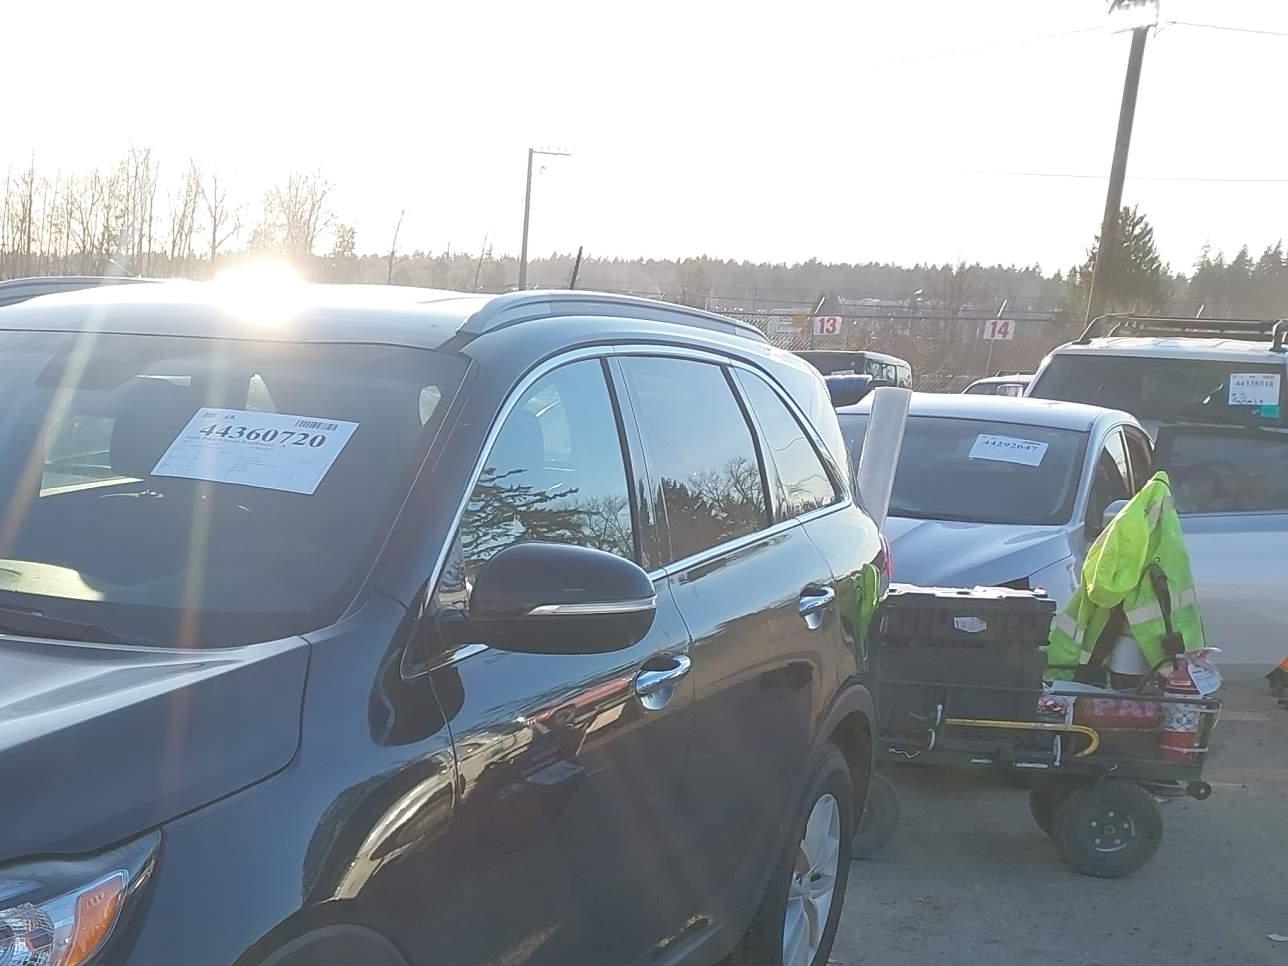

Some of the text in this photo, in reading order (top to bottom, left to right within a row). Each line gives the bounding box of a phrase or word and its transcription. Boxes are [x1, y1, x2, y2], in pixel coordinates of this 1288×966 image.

[818, 317, 837, 334] 13
[989, 319, 1010, 338] 14
[199, 423, 326, 448] 44360720
